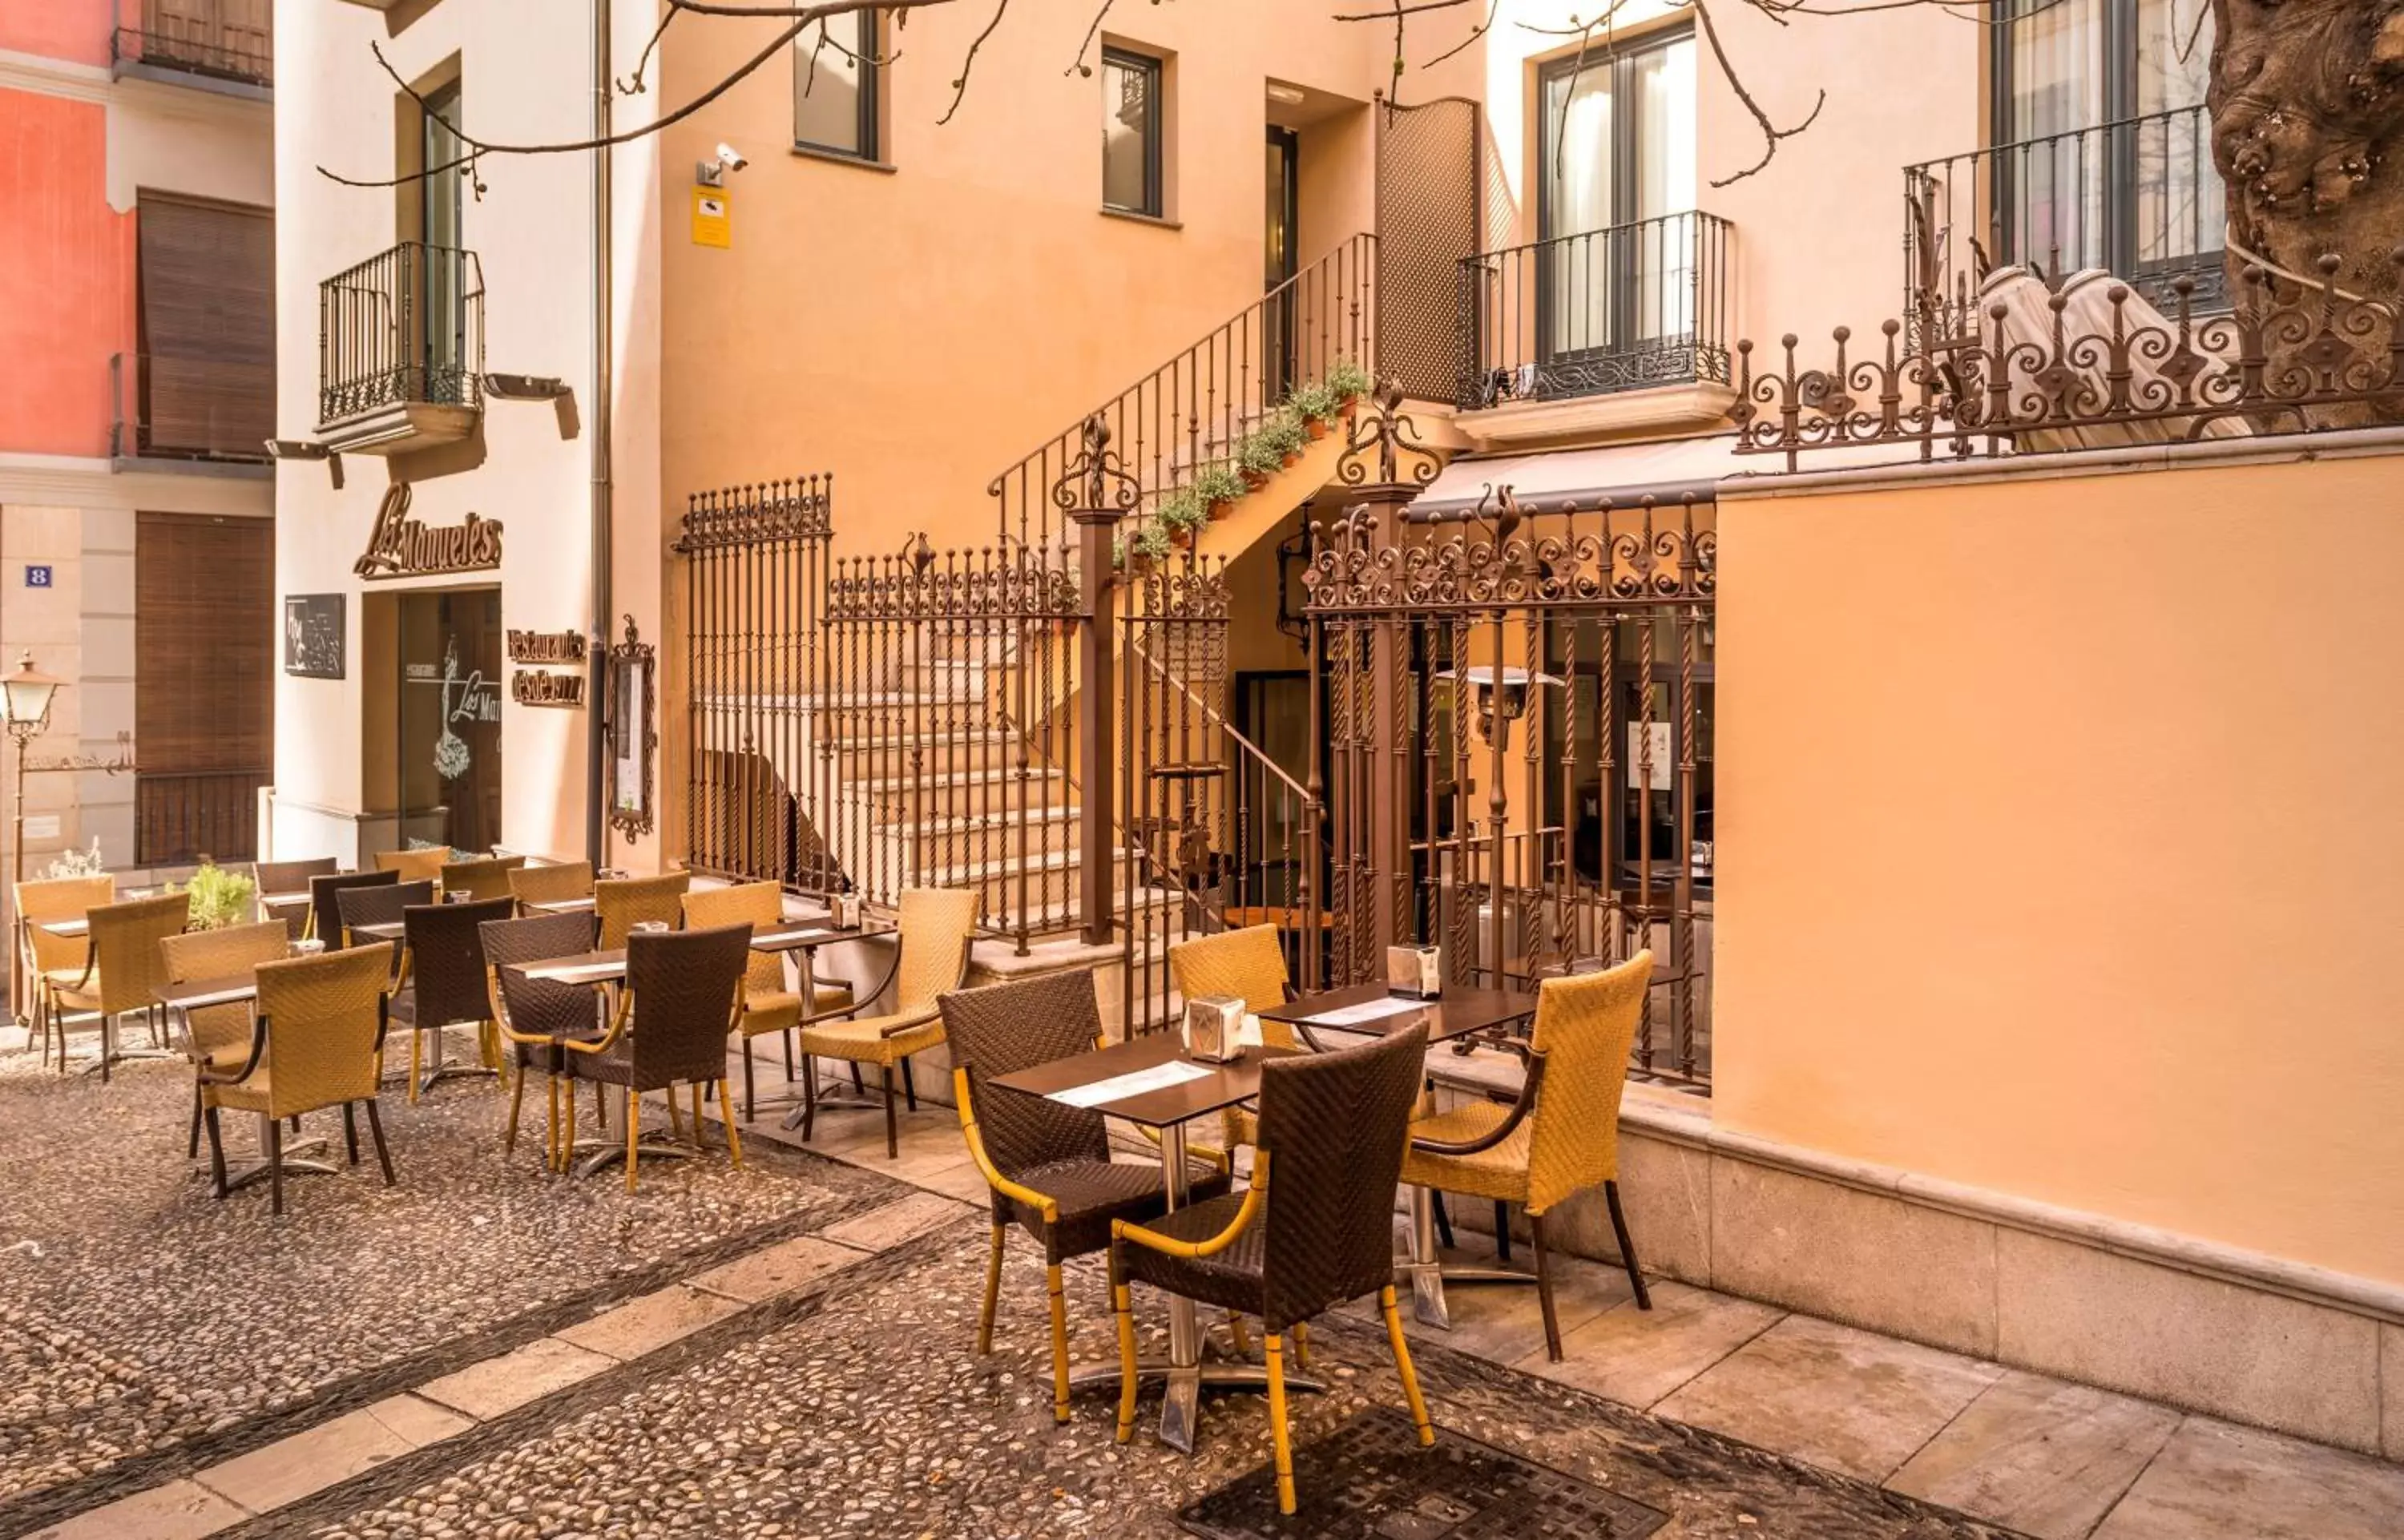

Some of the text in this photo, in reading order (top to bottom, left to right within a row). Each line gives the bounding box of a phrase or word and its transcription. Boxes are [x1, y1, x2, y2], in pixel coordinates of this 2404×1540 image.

[353, 482, 503, 575] Los Manueles
[32, 570, 46, 584] 8
[450, 670, 481, 722] Los
